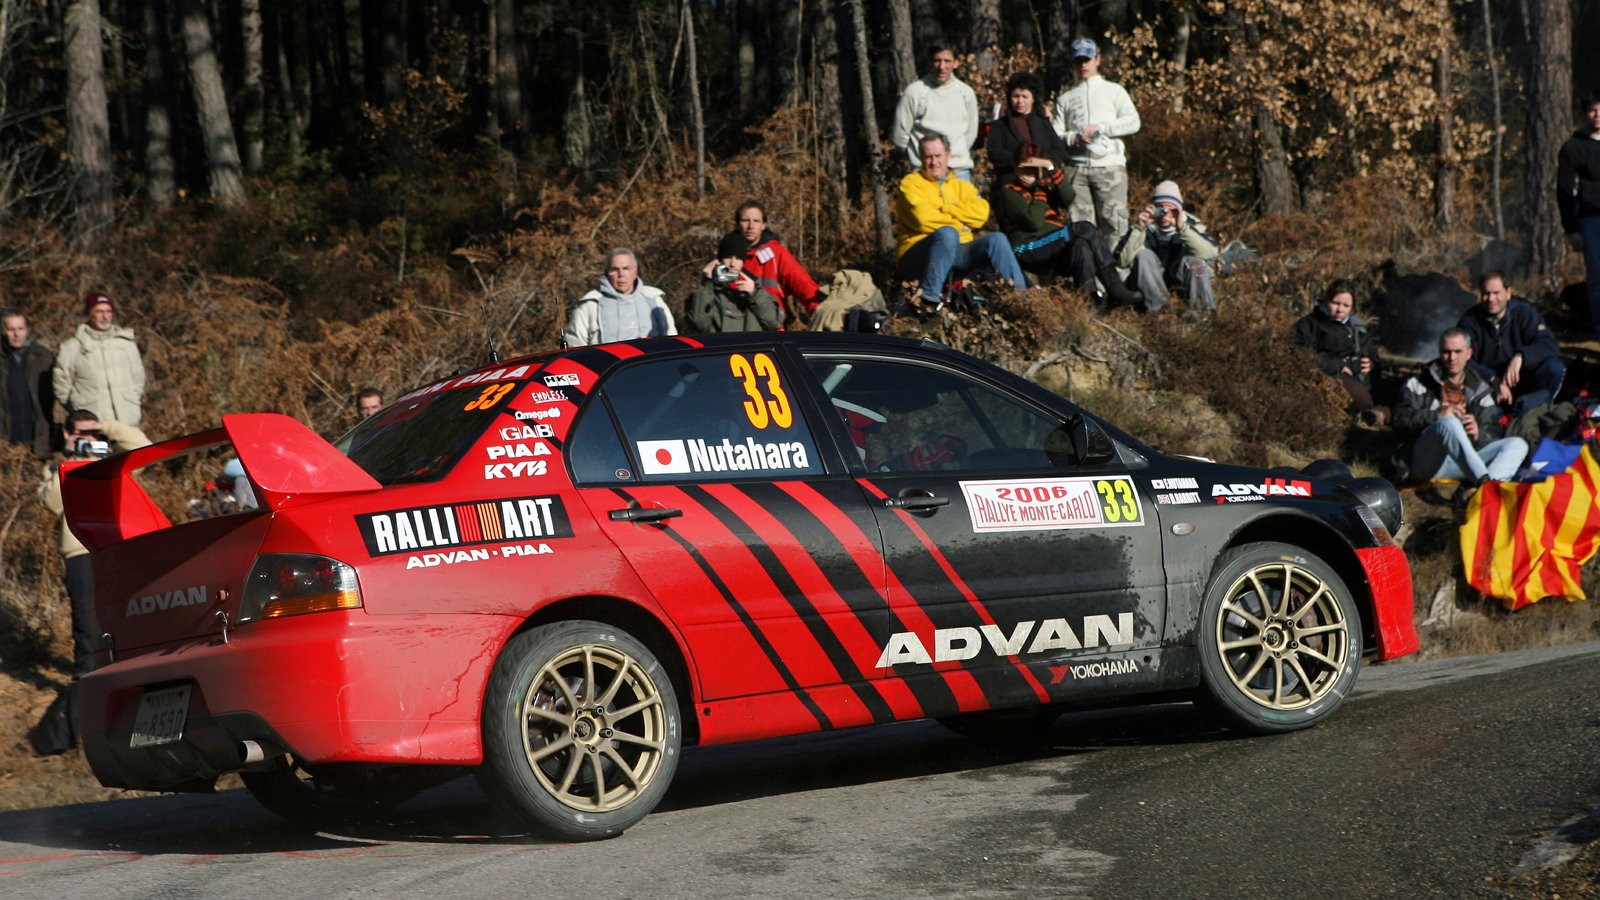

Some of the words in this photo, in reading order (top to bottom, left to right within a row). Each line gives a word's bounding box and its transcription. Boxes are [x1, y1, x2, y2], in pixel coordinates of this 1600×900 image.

[453, 365, 531, 388] PIAA
[544, 374, 580, 387] HKS
[463, 382, 517, 411] 33
[729, 353, 793, 430] 33
[501, 424, 554, 441] GAB
[486, 441, 552, 460] PIAA
[686, 436, 810, 472] Nutahara
[484, 460, 548, 480] KYB
[995, 486, 1068, 503] 2006
[1096, 479, 1138, 523] 33
[1211, 483, 1310, 497] ADVAN
[1225, 495, 1266, 503] YOKOHAMA
[974, 494, 1018, 524] RALLYE
[371, 506, 460, 553] RALLI
[501, 498, 555, 539] ART
[406, 548, 490, 570] ADVAN
[500, 543, 554, 556] PIAA
[125, 585, 207, 618] ADVAN
[874, 612, 1135, 669] ADVAN
[1068, 658, 1140, 680] YOKOHAMA
